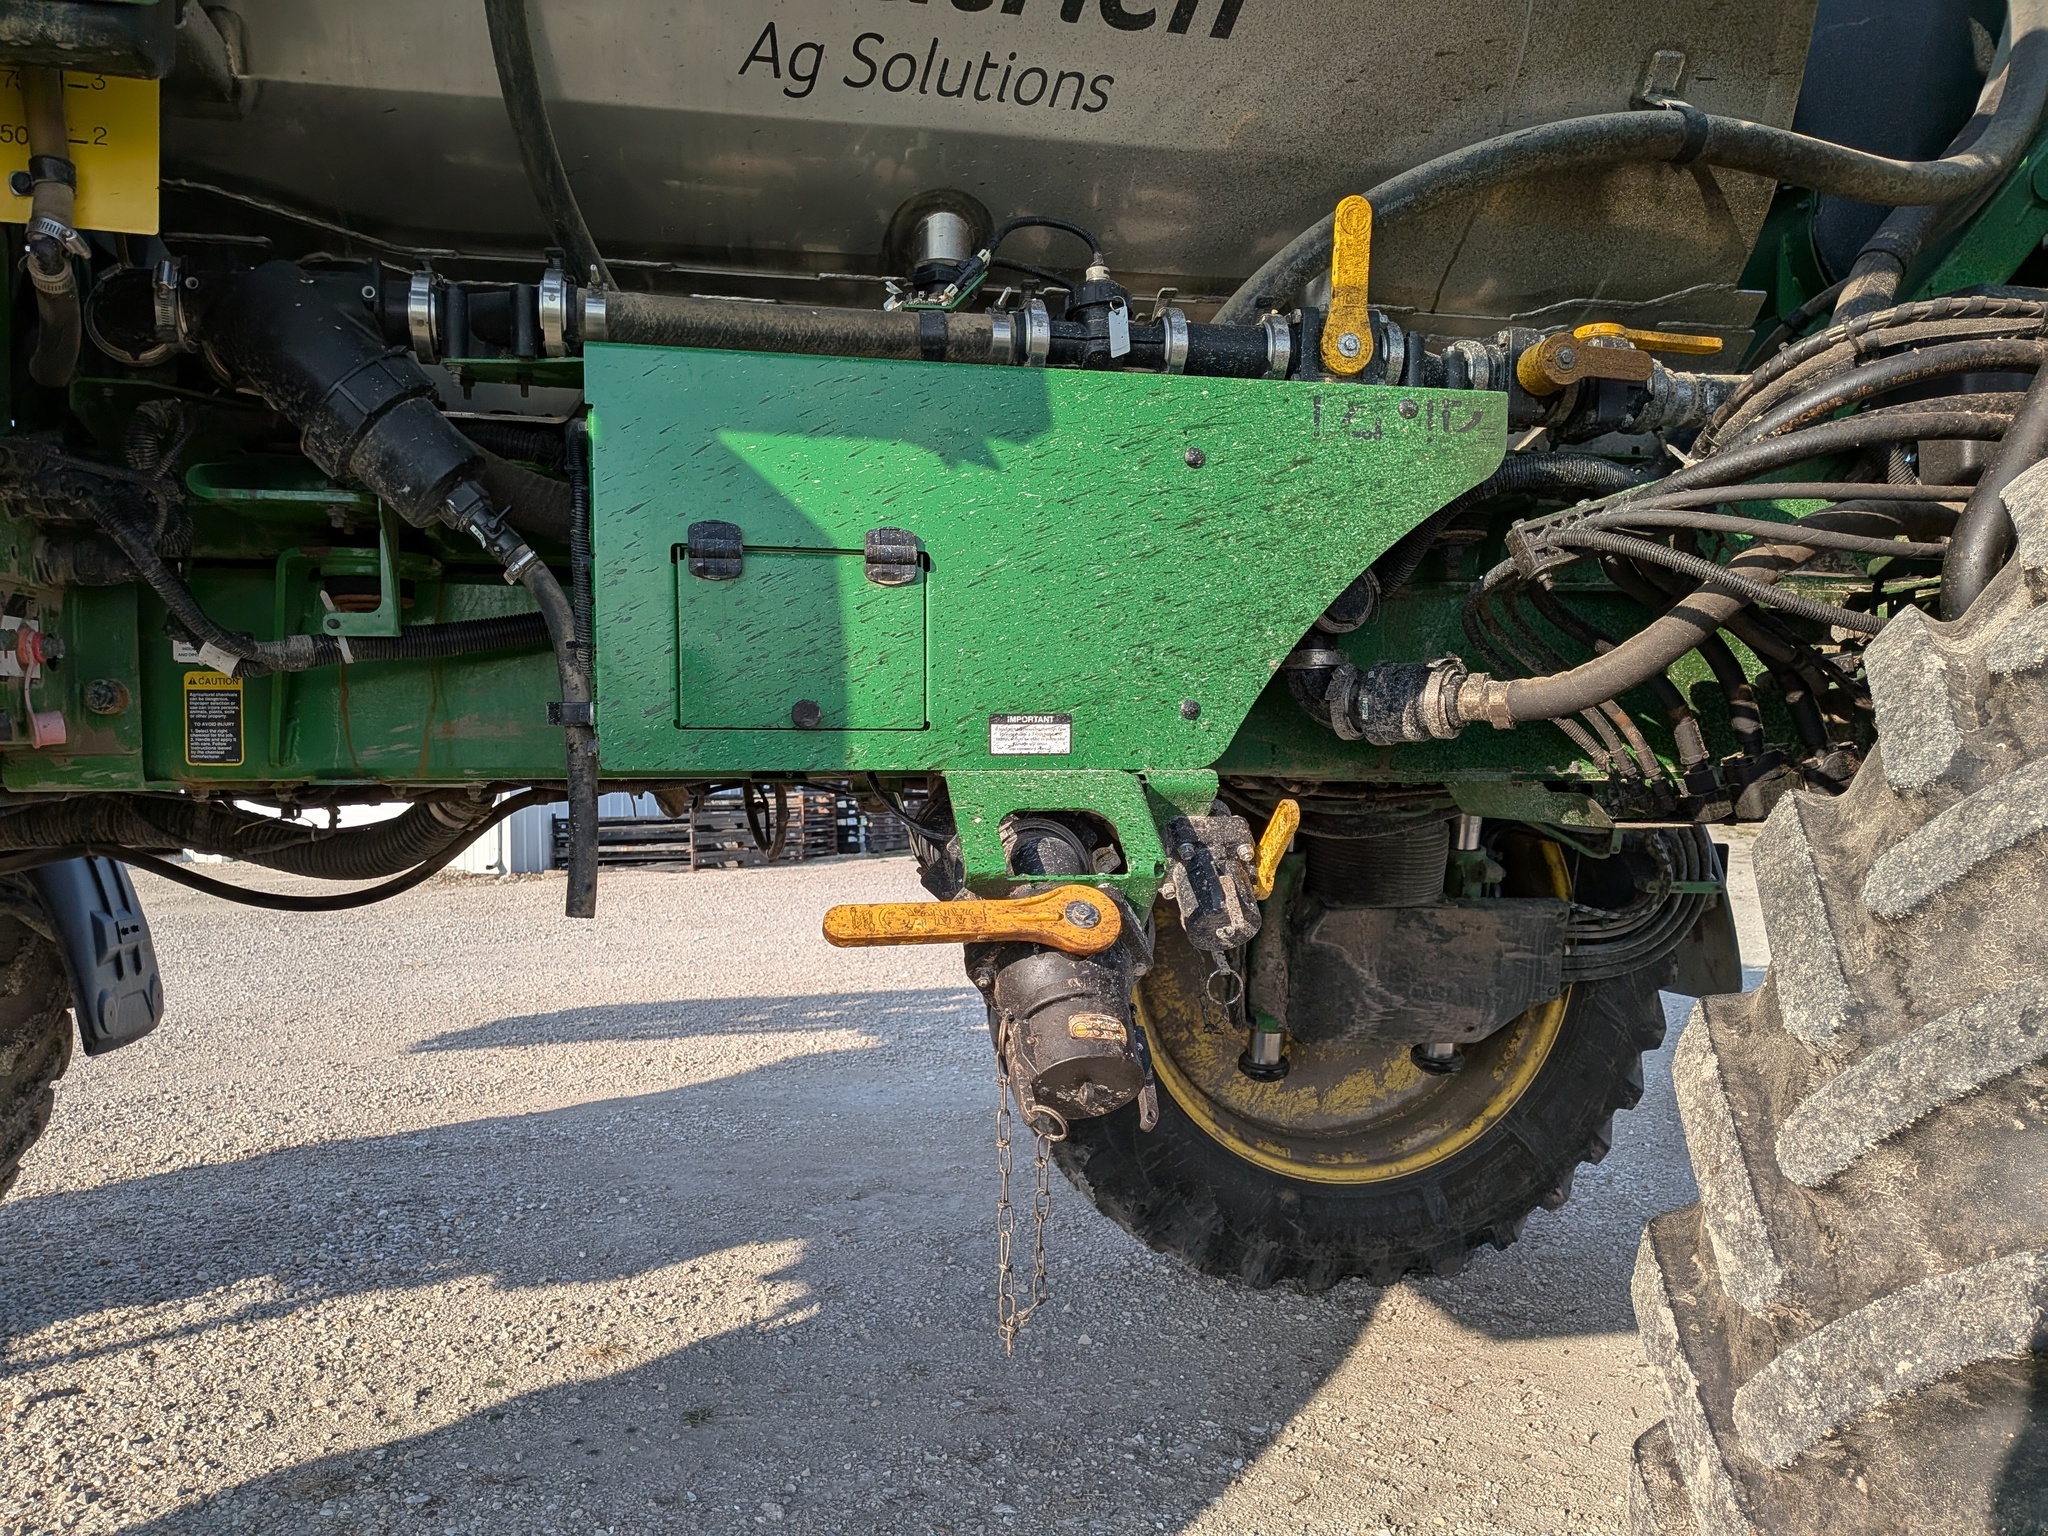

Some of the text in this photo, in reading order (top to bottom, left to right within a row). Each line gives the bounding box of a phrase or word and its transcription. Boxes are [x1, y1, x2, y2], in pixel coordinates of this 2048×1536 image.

[738, 21, 1115, 113] Ag Solutions
[91, 74, 106, 91] 3
[93, 126, 108, 146] 2
[198, 677, 239, 685] CAUTION
[1007, 715, 1055, 723] IMPORTANT
